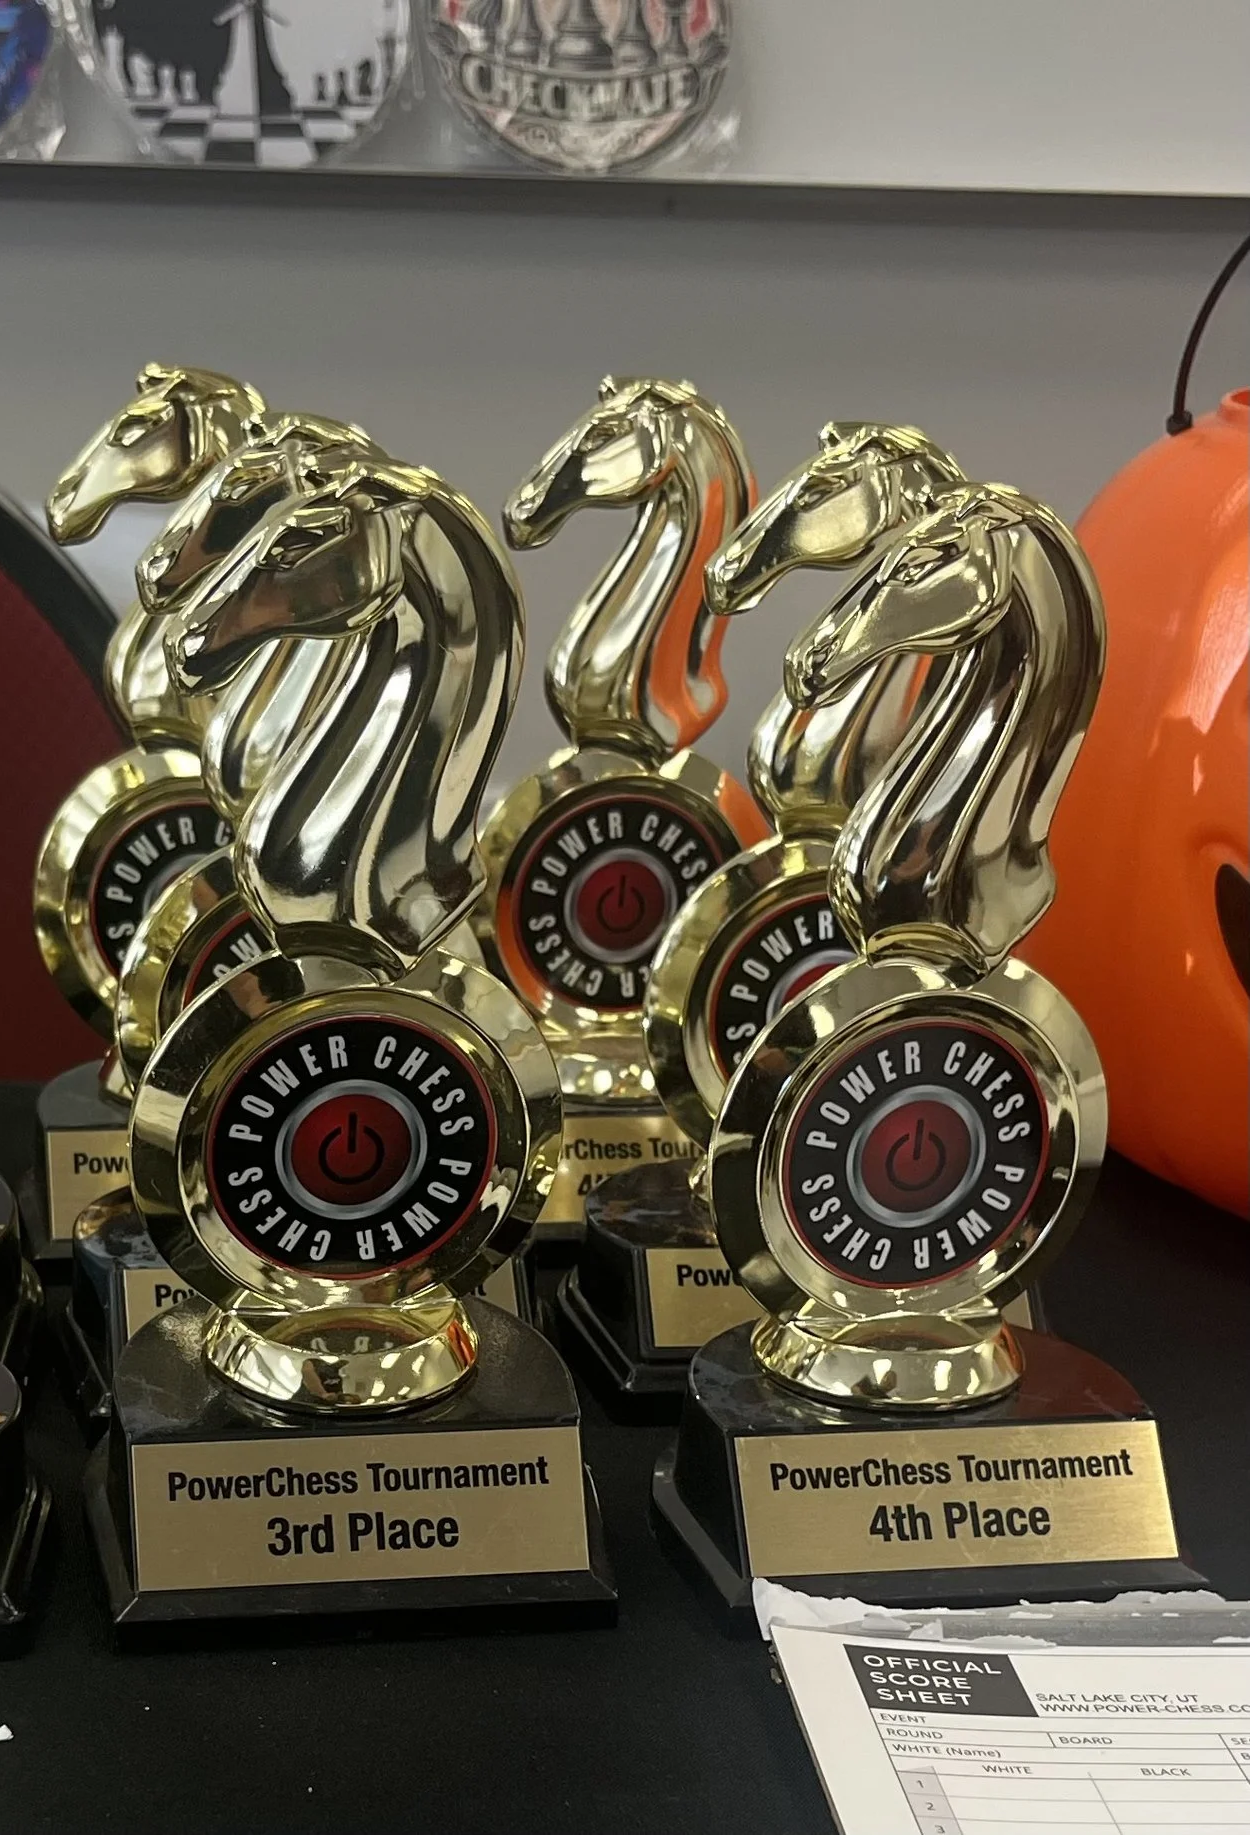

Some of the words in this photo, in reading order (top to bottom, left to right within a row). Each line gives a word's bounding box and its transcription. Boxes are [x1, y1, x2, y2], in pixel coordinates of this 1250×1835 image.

[105, 815, 197, 905] POWER
[531, 810, 624, 897] POWER
[639, 813, 708, 896] CHES
[528, 914, 604, 997] CHESS
[729, 909, 835, 1003] POWER
[227, 1034, 349, 1143] POWER
[373, 1035, 476, 1137] CHESS
[805, 1040, 922, 1150] POWER
[943, 1040, 1031, 1143] CHESS
[72, 1152, 129, 1175] Pow
[561, 1138, 643, 1161] rChess
[227, 1166, 332, 1262] CHESS
[355, 1157, 473, 1261] POWER
[801, 1173, 892, 1271] CHESS
[912, 1163, 1026, 1270] POWER
[676, 1263, 743, 1287] Pow
[168, 1466, 359, 1502] PowerChess
[366, 1456, 550, 1493] Tournament
[770, 1458, 951, 1491] PowerChess
[957, 1448, 1133, 1484] Tournament
[267, 1513, 335, 1557] 3rd
[349, 1512, 460, 1552] Place
[869, 1504, 933, 1542] 4th
[943, 1500, 1051, 1540] Place
[862, 1654, 1002, 1675] OFFICIAL
[869, 1671, 973, 1690] SCORE
[876, 1687, 972, 1706] SHEET
[1036, 1693, 1077, 1703] SALT
[1081, 1693, 1126, 1703] LAKE
[1176, 1693, 1199, 1703] UT
[880, 1712, 927, 1724] EVENT
[886, 1727, 944, 1740] ROUND
[892, 1743, 942, 1755] WHITE
[945, 1746, 1002, 1759] (Name)
[1058, 1736, 1113, 1745] BOARD
[916, 1780, 924, 1788] 1
[981, 1764, 1034, 1775] WHITE
[1140, 1767, 1192, 1776] BLACK
[926, 1802, 935, 1811] 2
[934, 1825, 946, 1834] 3
